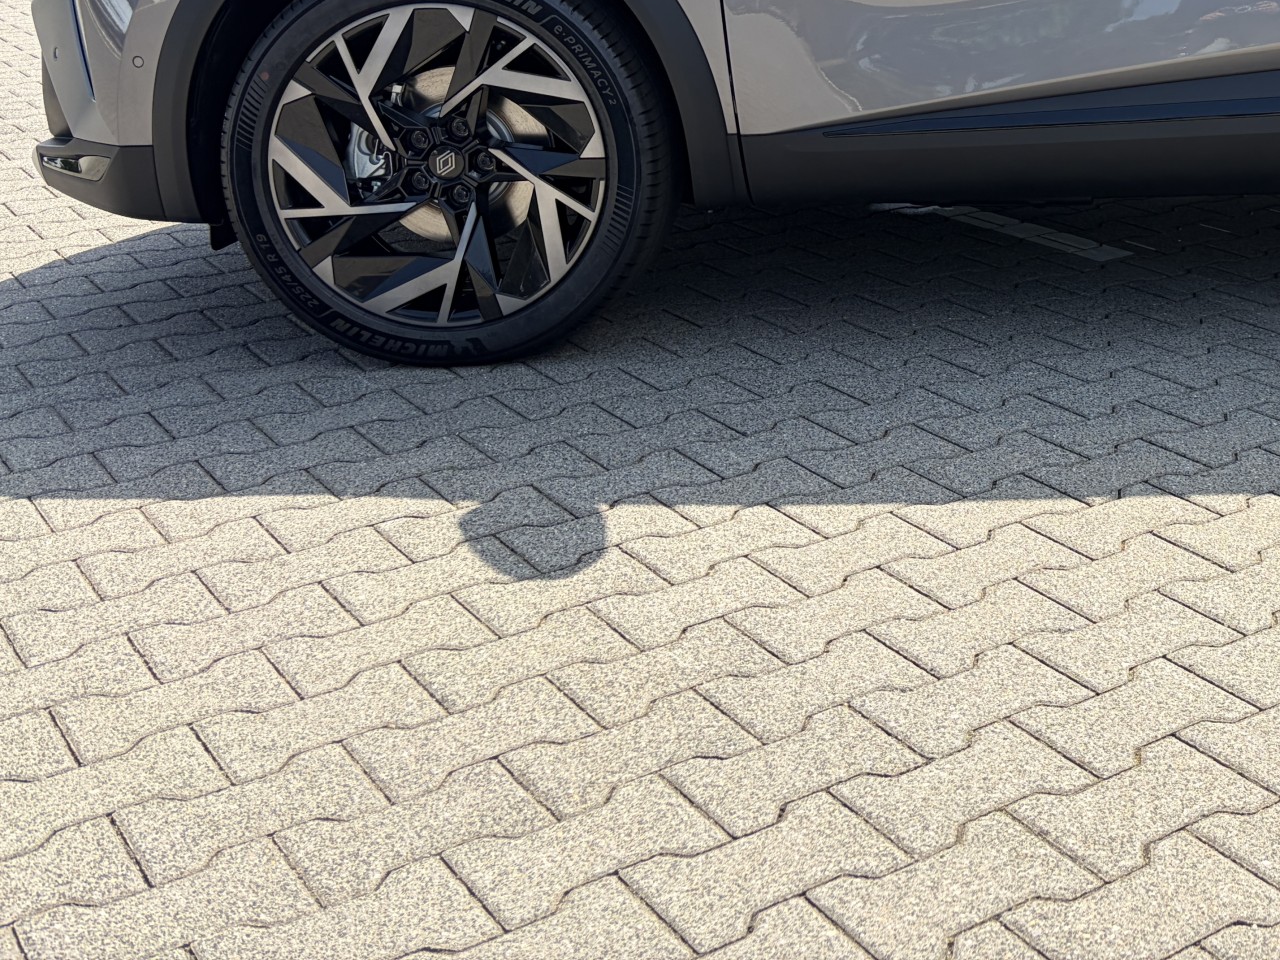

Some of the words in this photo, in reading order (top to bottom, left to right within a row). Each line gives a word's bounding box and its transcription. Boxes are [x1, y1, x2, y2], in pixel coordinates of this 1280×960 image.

[256, 233, 271, 249] 19
[266, 253, 279, 262] R
[274, 266, 319, 307] 225/45
[329, 317, 449, 357] MICHELIN
